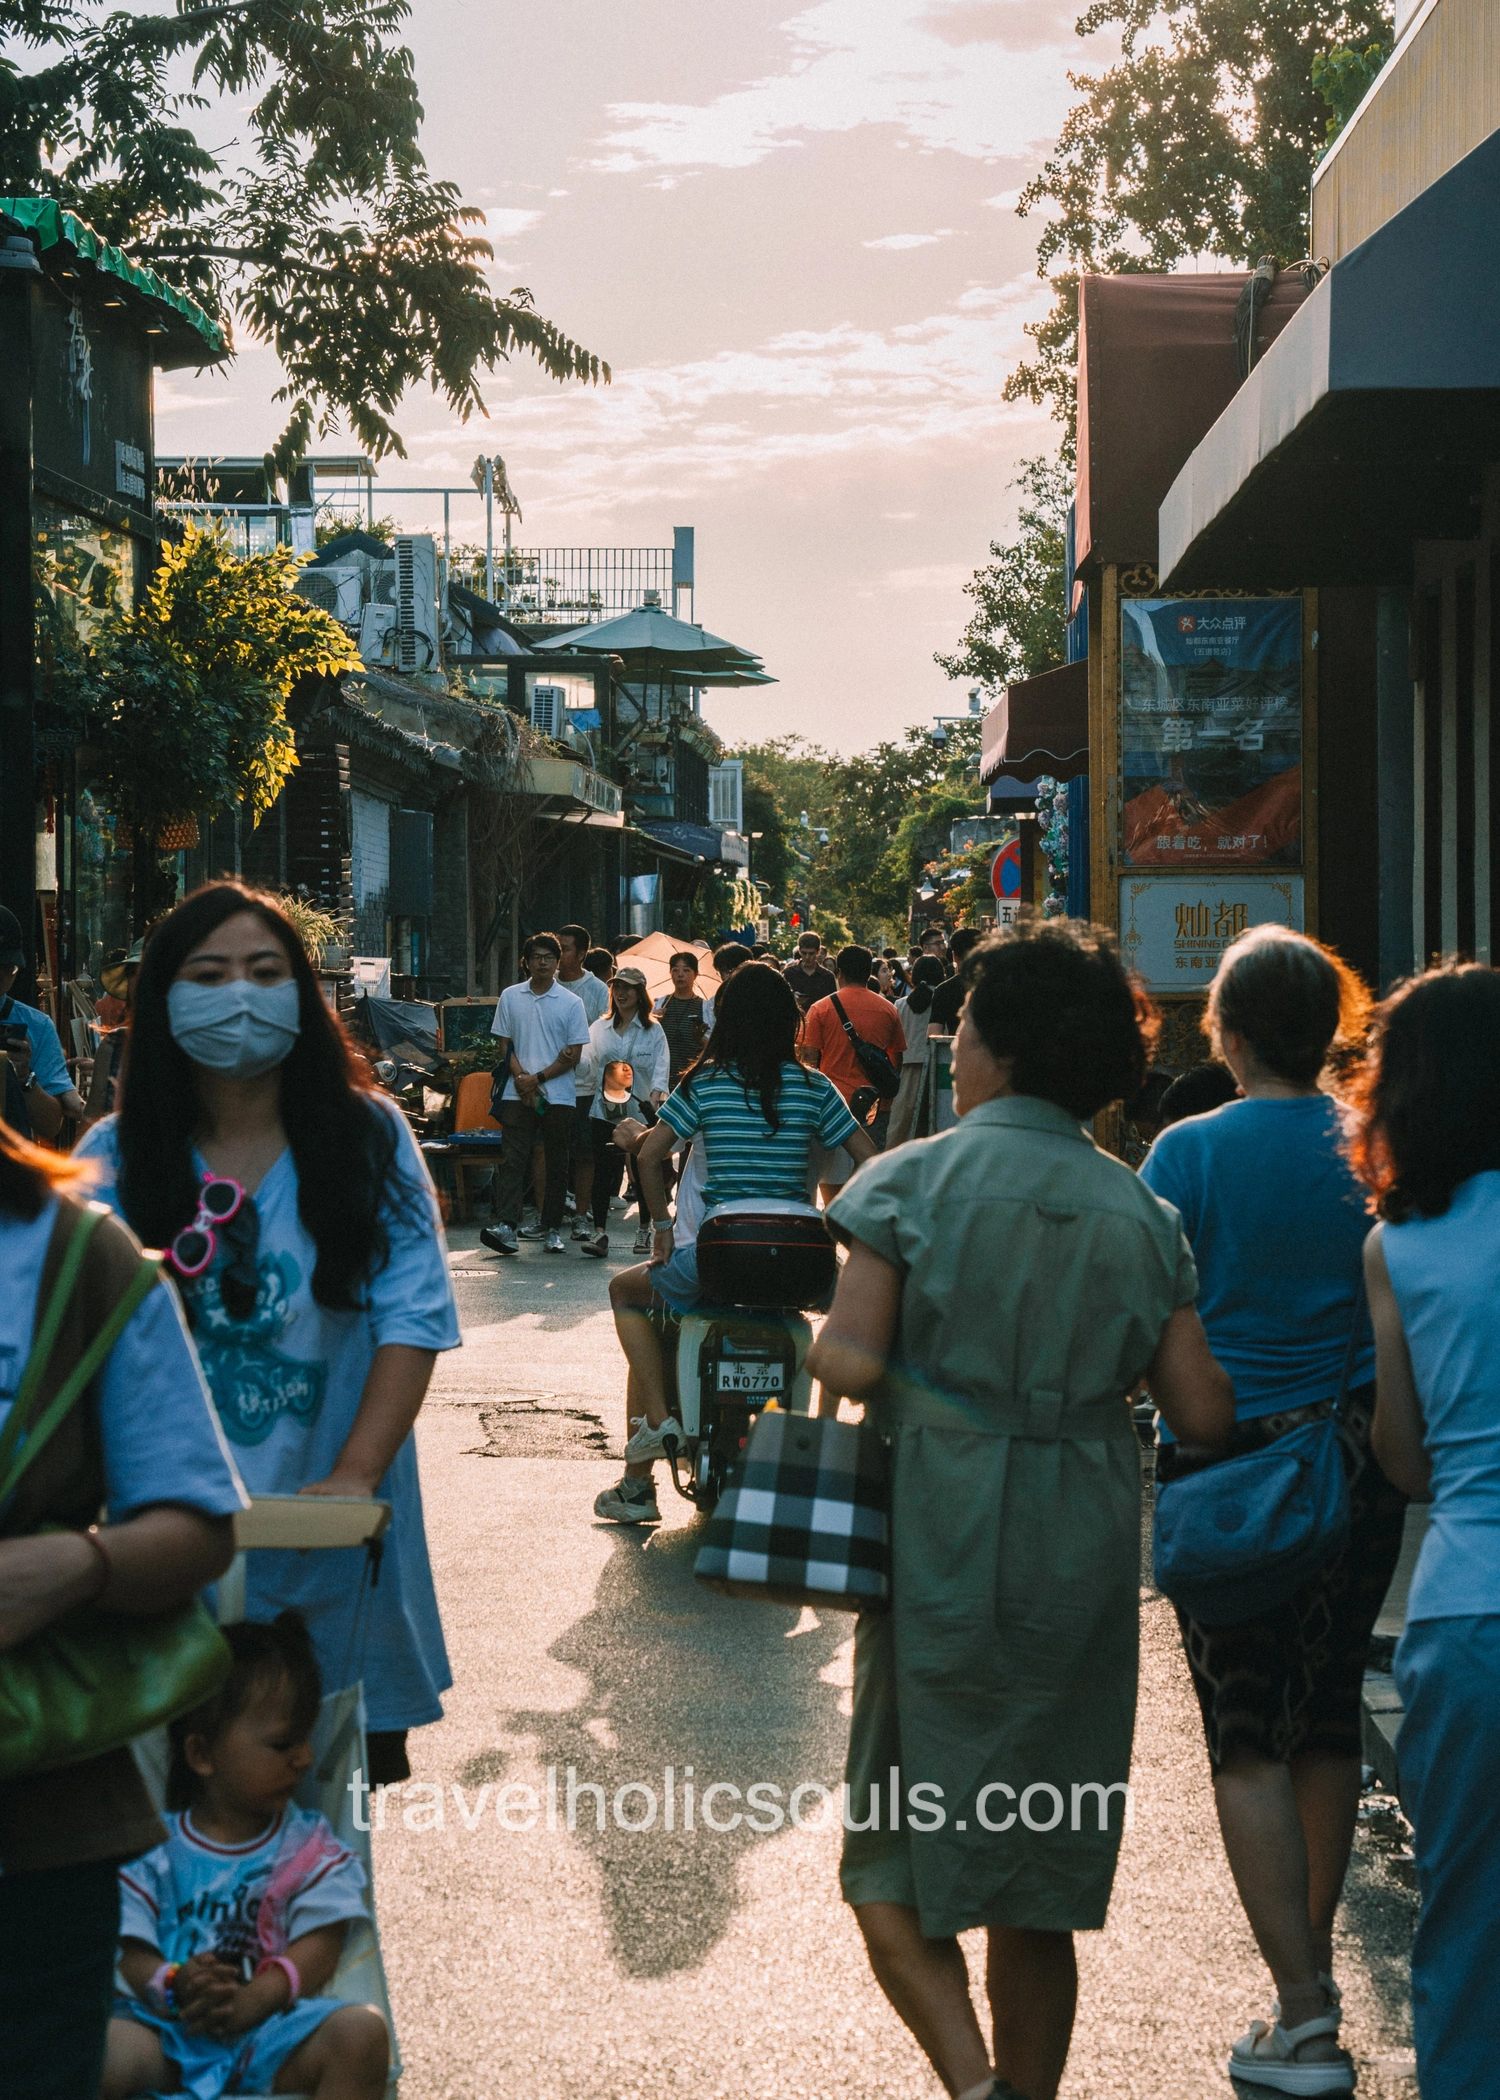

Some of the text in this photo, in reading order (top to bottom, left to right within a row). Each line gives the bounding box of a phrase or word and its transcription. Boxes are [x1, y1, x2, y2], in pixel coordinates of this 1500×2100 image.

[1197, 616, 1246, 630] 大众点评
[1141, 697, 1289, 712] 东城区东南亚菜好评榜
[1161, 716, 1264, 752] 第一名
[1175, 899, 1248, 938] 灿都
[1174, 939, 1221, 949] SHINING
[733, 1363, 769, 1375] 北京
[722, 1375, 780, 1389] RW0770
